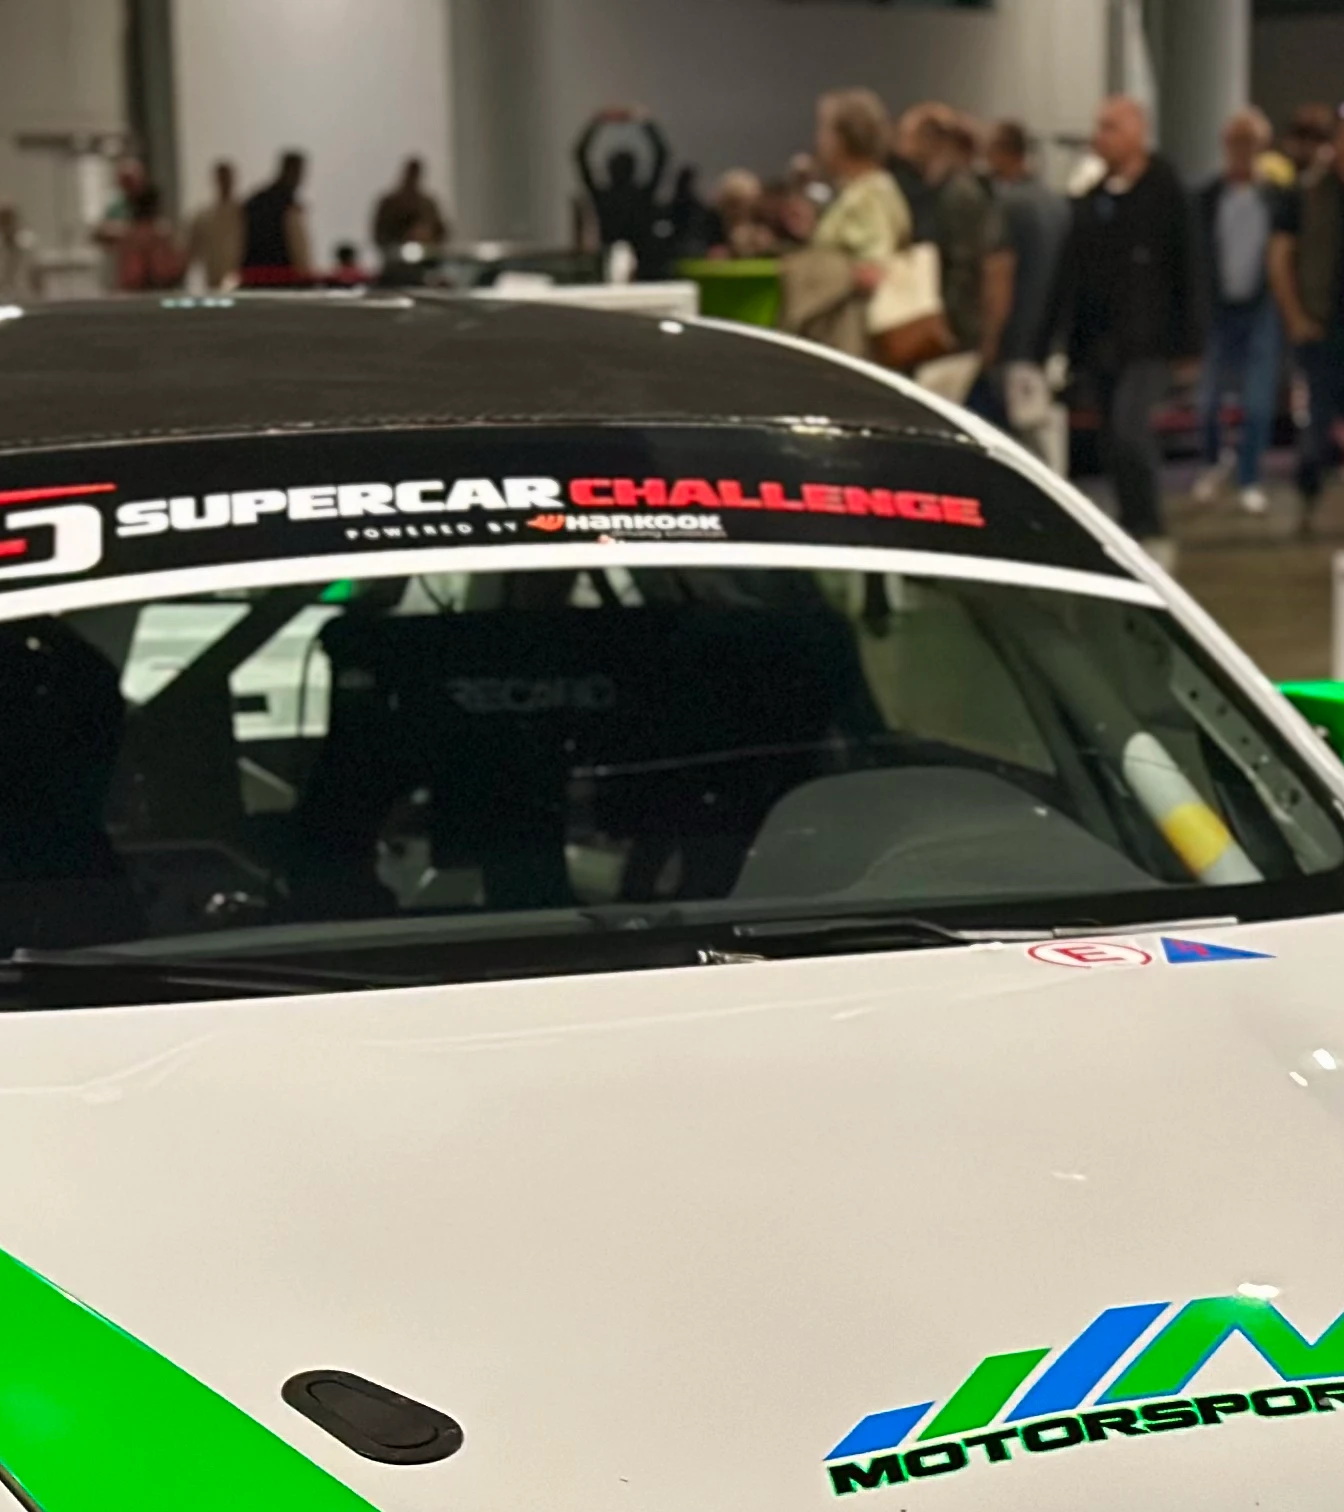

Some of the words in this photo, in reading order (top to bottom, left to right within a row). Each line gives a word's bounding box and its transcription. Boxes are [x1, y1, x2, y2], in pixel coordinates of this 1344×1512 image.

[115, 476, 564, 538] SUPERCAR
[567, 477, 986, 527] CHALLENGE
[344, 522, 474, 540] POWERED
[486, 521, 518, 534] BY
